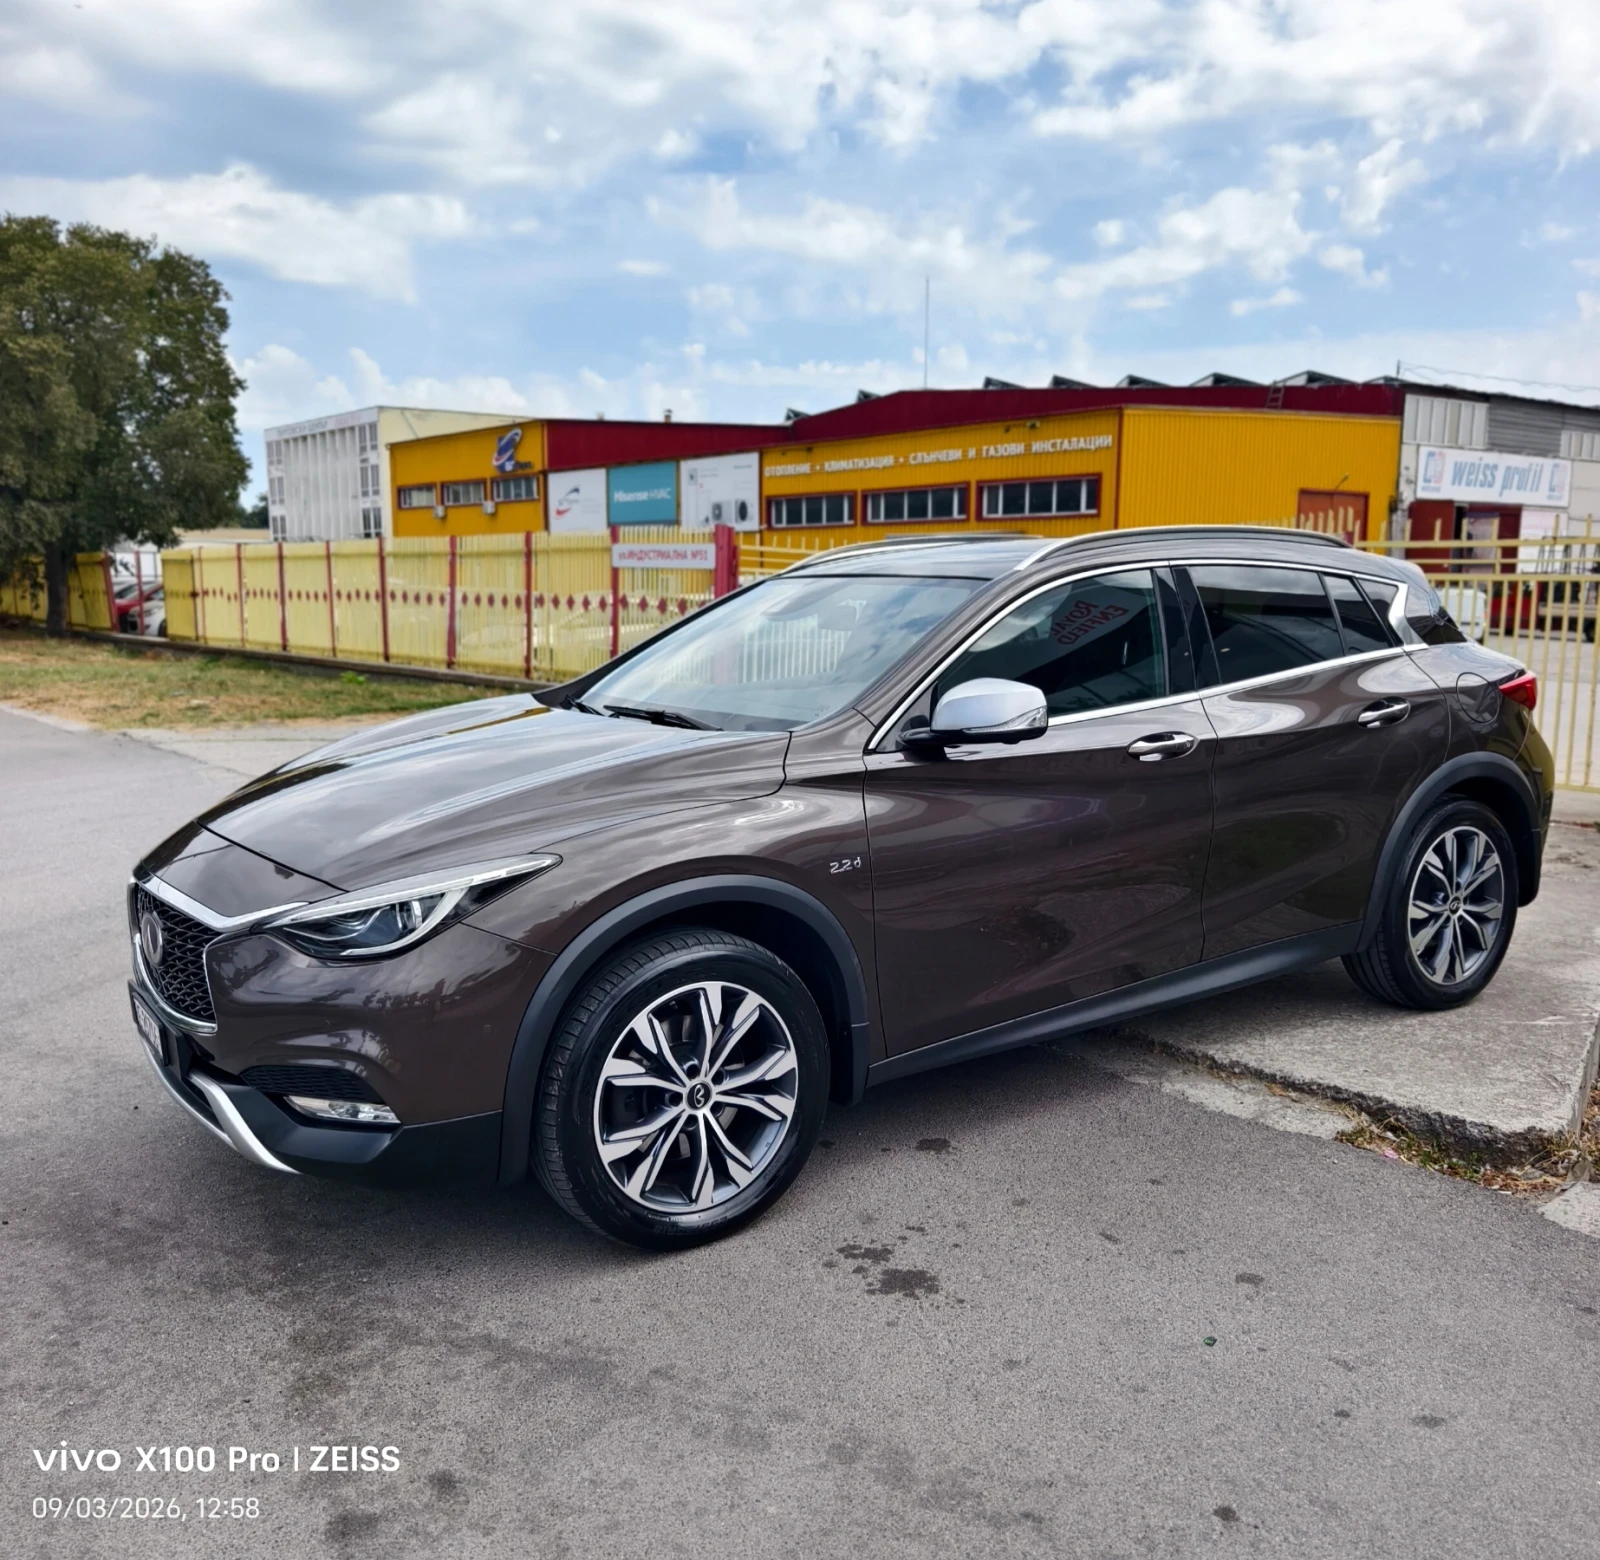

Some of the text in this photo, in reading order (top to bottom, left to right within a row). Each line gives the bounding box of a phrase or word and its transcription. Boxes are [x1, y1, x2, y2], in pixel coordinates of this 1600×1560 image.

[764, 434, 1113, 477] ОТОПЛЕНИЕ КЛИМАТИЗАЦИЯ СЛЪНЧЕВИ И ГАЗОВИ ИНСТАЛАЦИИ
[613, 489, 649, 503] Hisense
[1451, 457, 1544, 497] weiss profil
